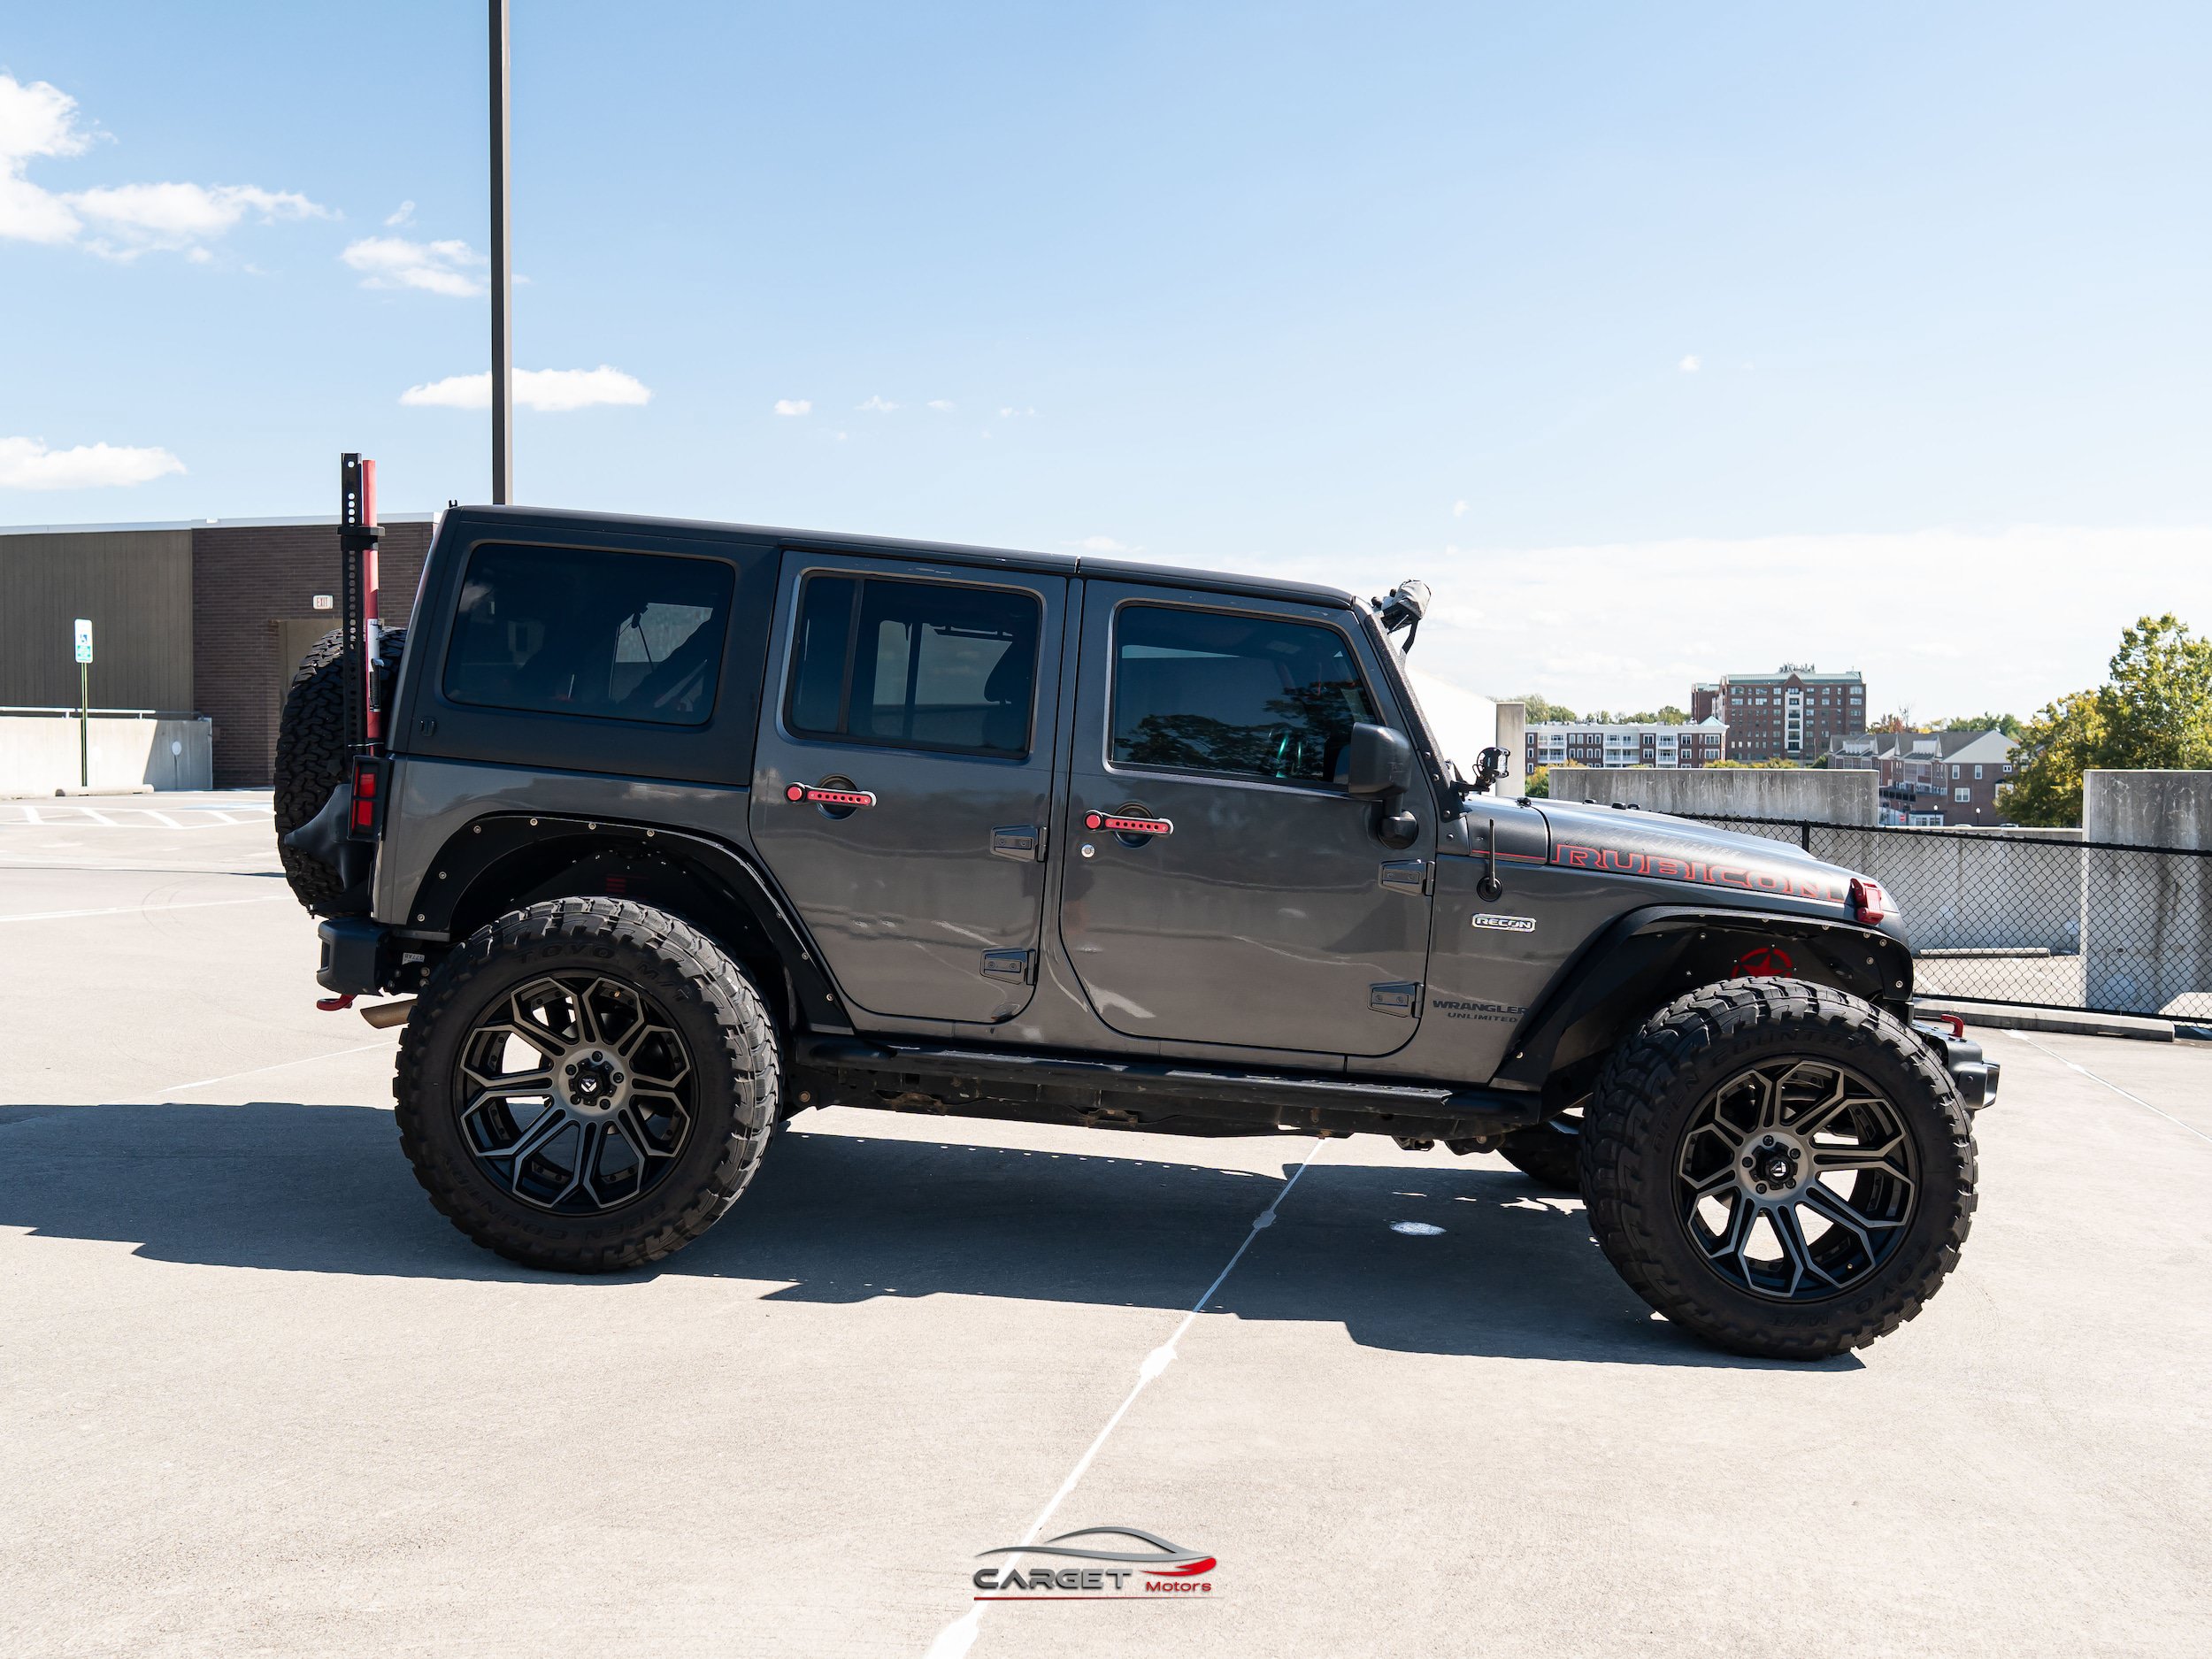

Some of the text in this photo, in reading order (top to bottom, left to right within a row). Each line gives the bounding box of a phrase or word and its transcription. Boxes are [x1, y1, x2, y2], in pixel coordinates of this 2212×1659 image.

[316, 597, 328, 607] EXIT
[1476, 918, 1531, 928] RECON
[1432, 1000, 1528, 1014] WRANGLER
[1448, 1012, 1517, 1023] UNLIMITED
